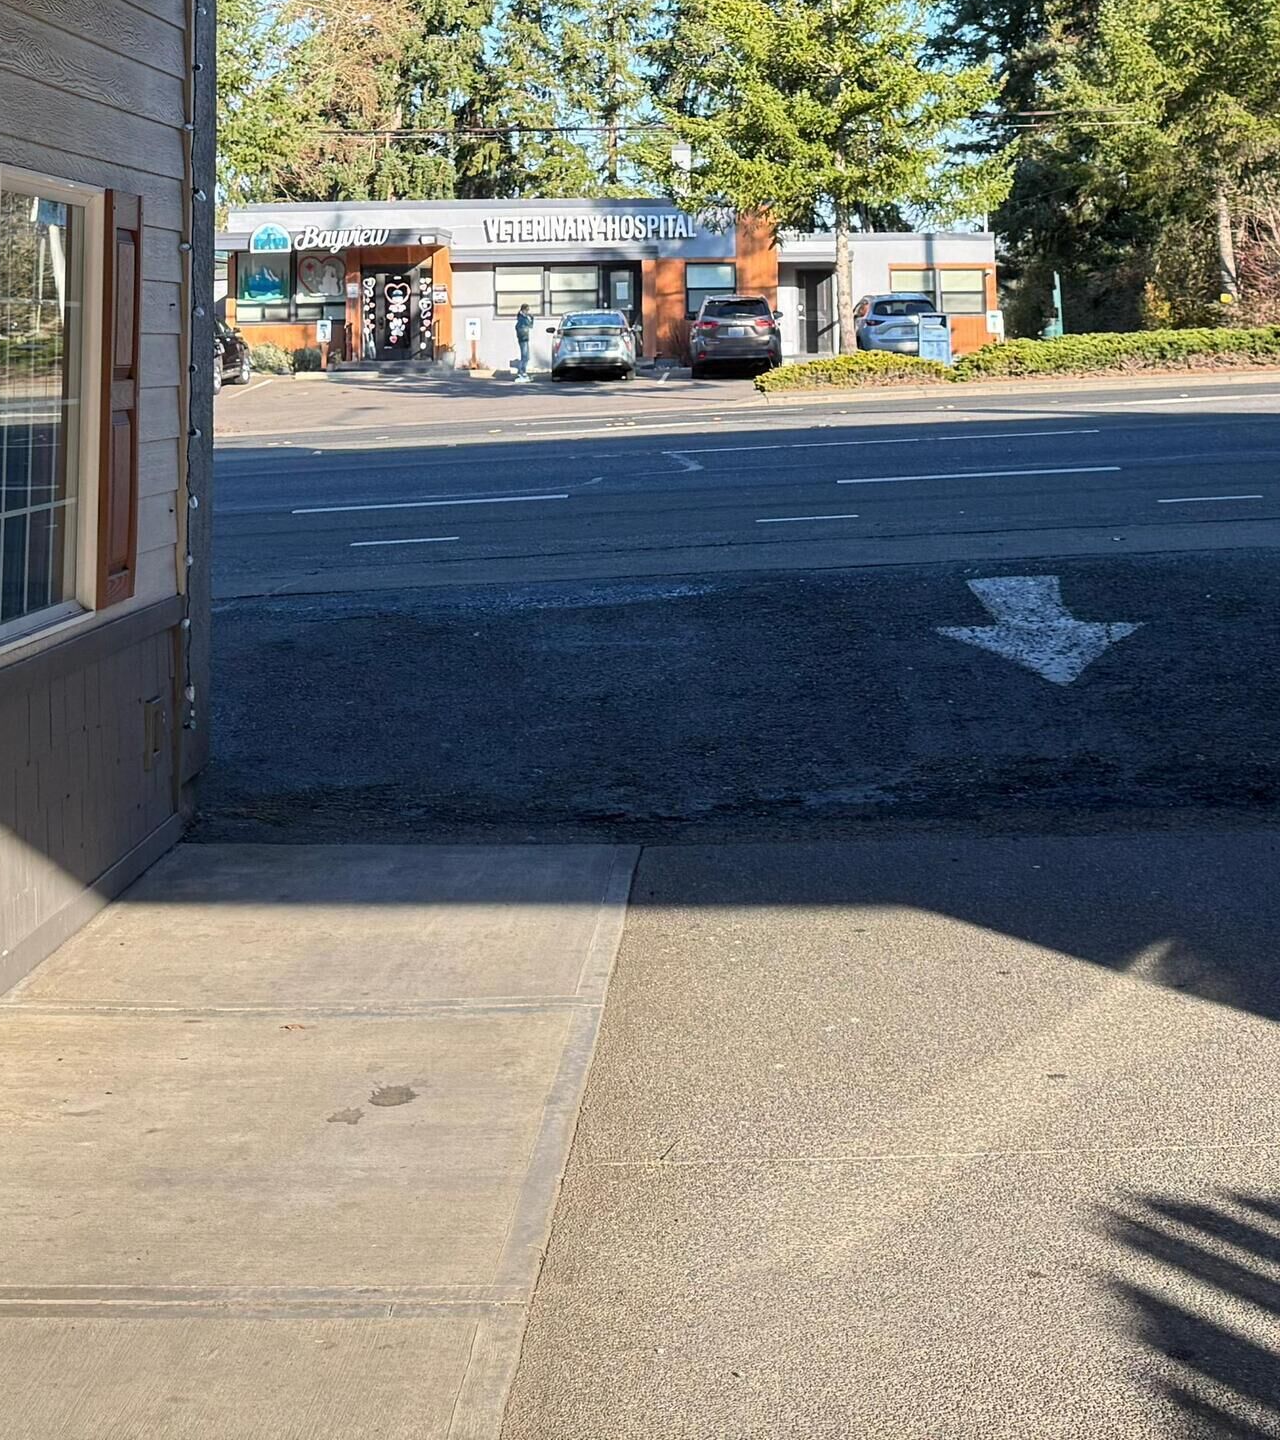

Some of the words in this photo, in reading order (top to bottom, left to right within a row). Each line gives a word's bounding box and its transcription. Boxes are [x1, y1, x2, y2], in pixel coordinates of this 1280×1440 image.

[294, 225, 390, 254] Bayview
[484, 215, 604, 241] VETERINARY
[606, 215, 697, 240] HOSPITAL
